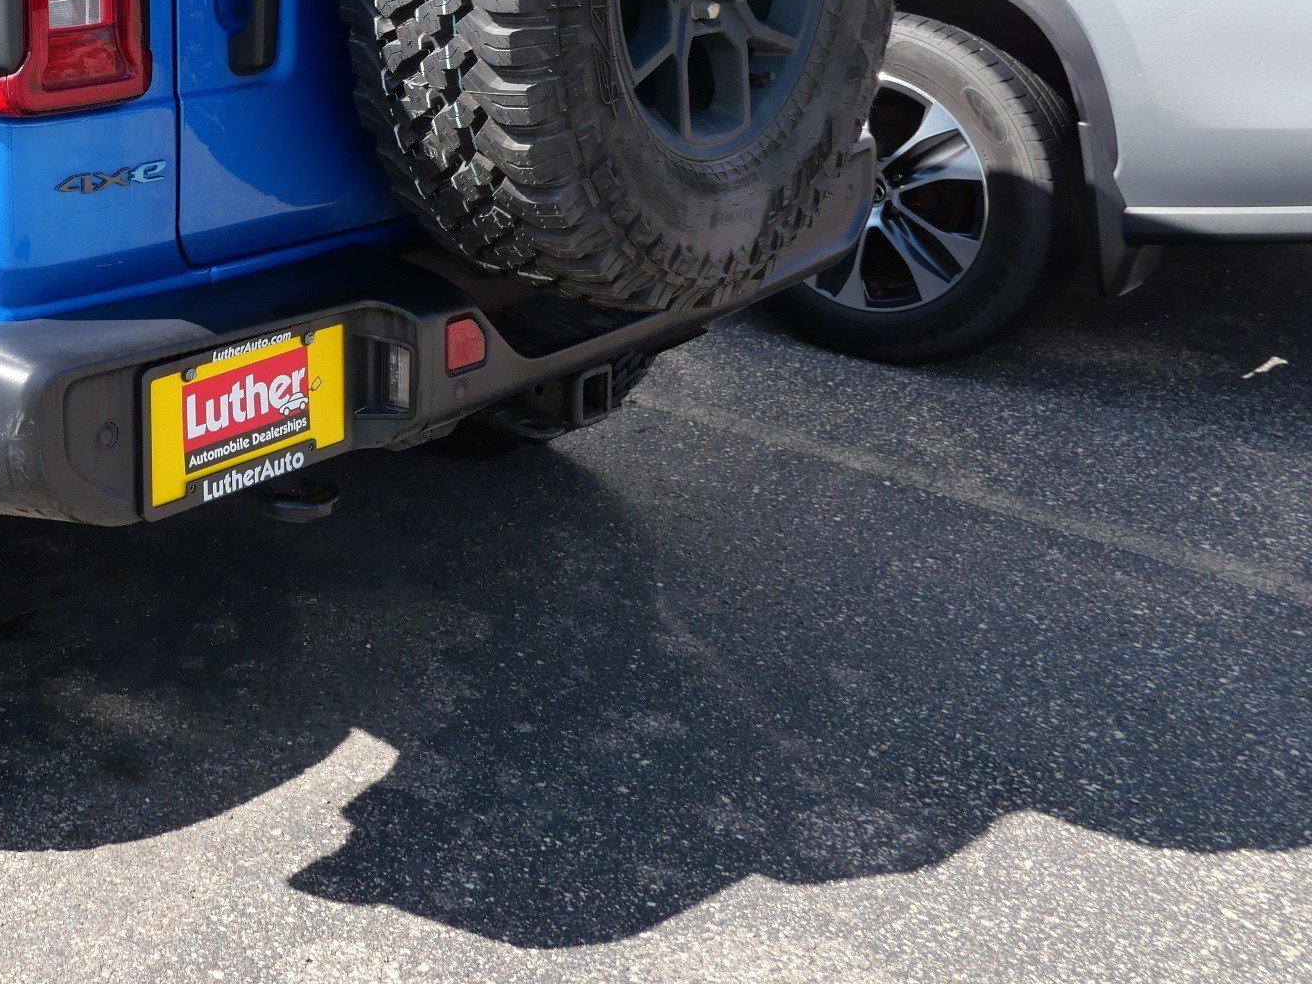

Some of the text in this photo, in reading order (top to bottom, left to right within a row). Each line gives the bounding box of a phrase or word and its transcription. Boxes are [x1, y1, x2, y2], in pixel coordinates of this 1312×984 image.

[54, 159, 167, 194] 4xe
[212, 331, 292, 363] LutherAuto.com
[186, 367, 306, 440] Luther
[189, 417, 308, 468] Automobile Dealerships
[203, 451, 305, 502] LutherAuto
